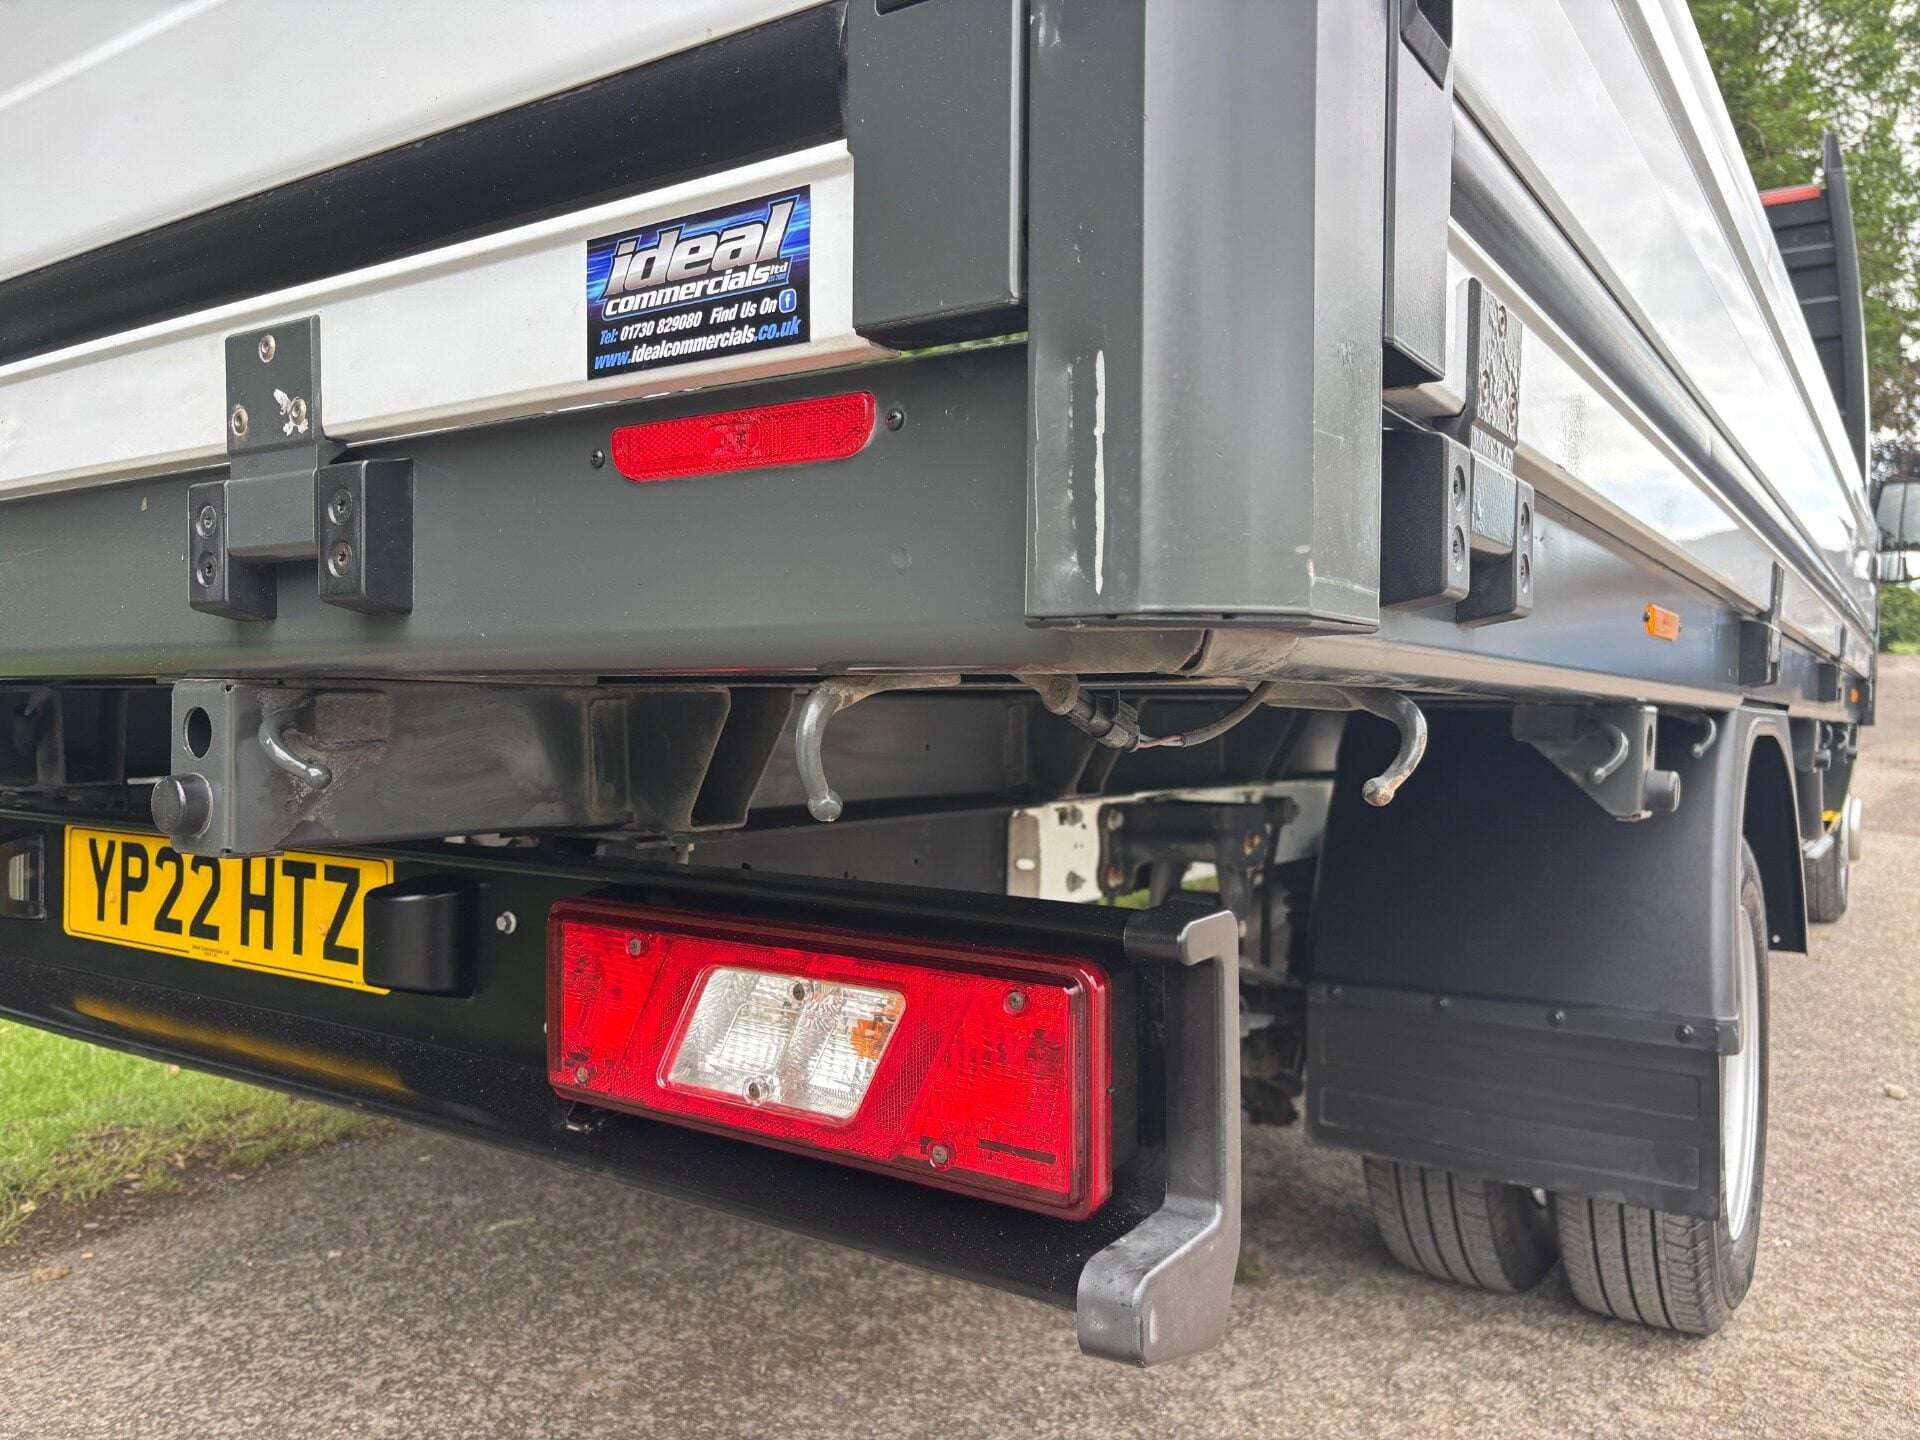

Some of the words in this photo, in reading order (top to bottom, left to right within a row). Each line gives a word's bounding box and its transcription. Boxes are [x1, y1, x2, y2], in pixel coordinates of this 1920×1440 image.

[603, 199, 795, 297] ideal
[605, 264, 771, 316] commercials
[769, 262, 788, 275] ltd
[594, 315, 801, 370] www.idealcommercials.co.uk
[600, 328, 618, 345] Tel:
[620, 320, 655, 341] 01730
[656, 311, 702, 334] 829080
[710, 303, 739, 324] Find
[740, 301, 757, 318] Us
[760, 297, 777, 315] On
[89, 838, 221, 942] YP22
[240, 857, 361, 966] HTZ
